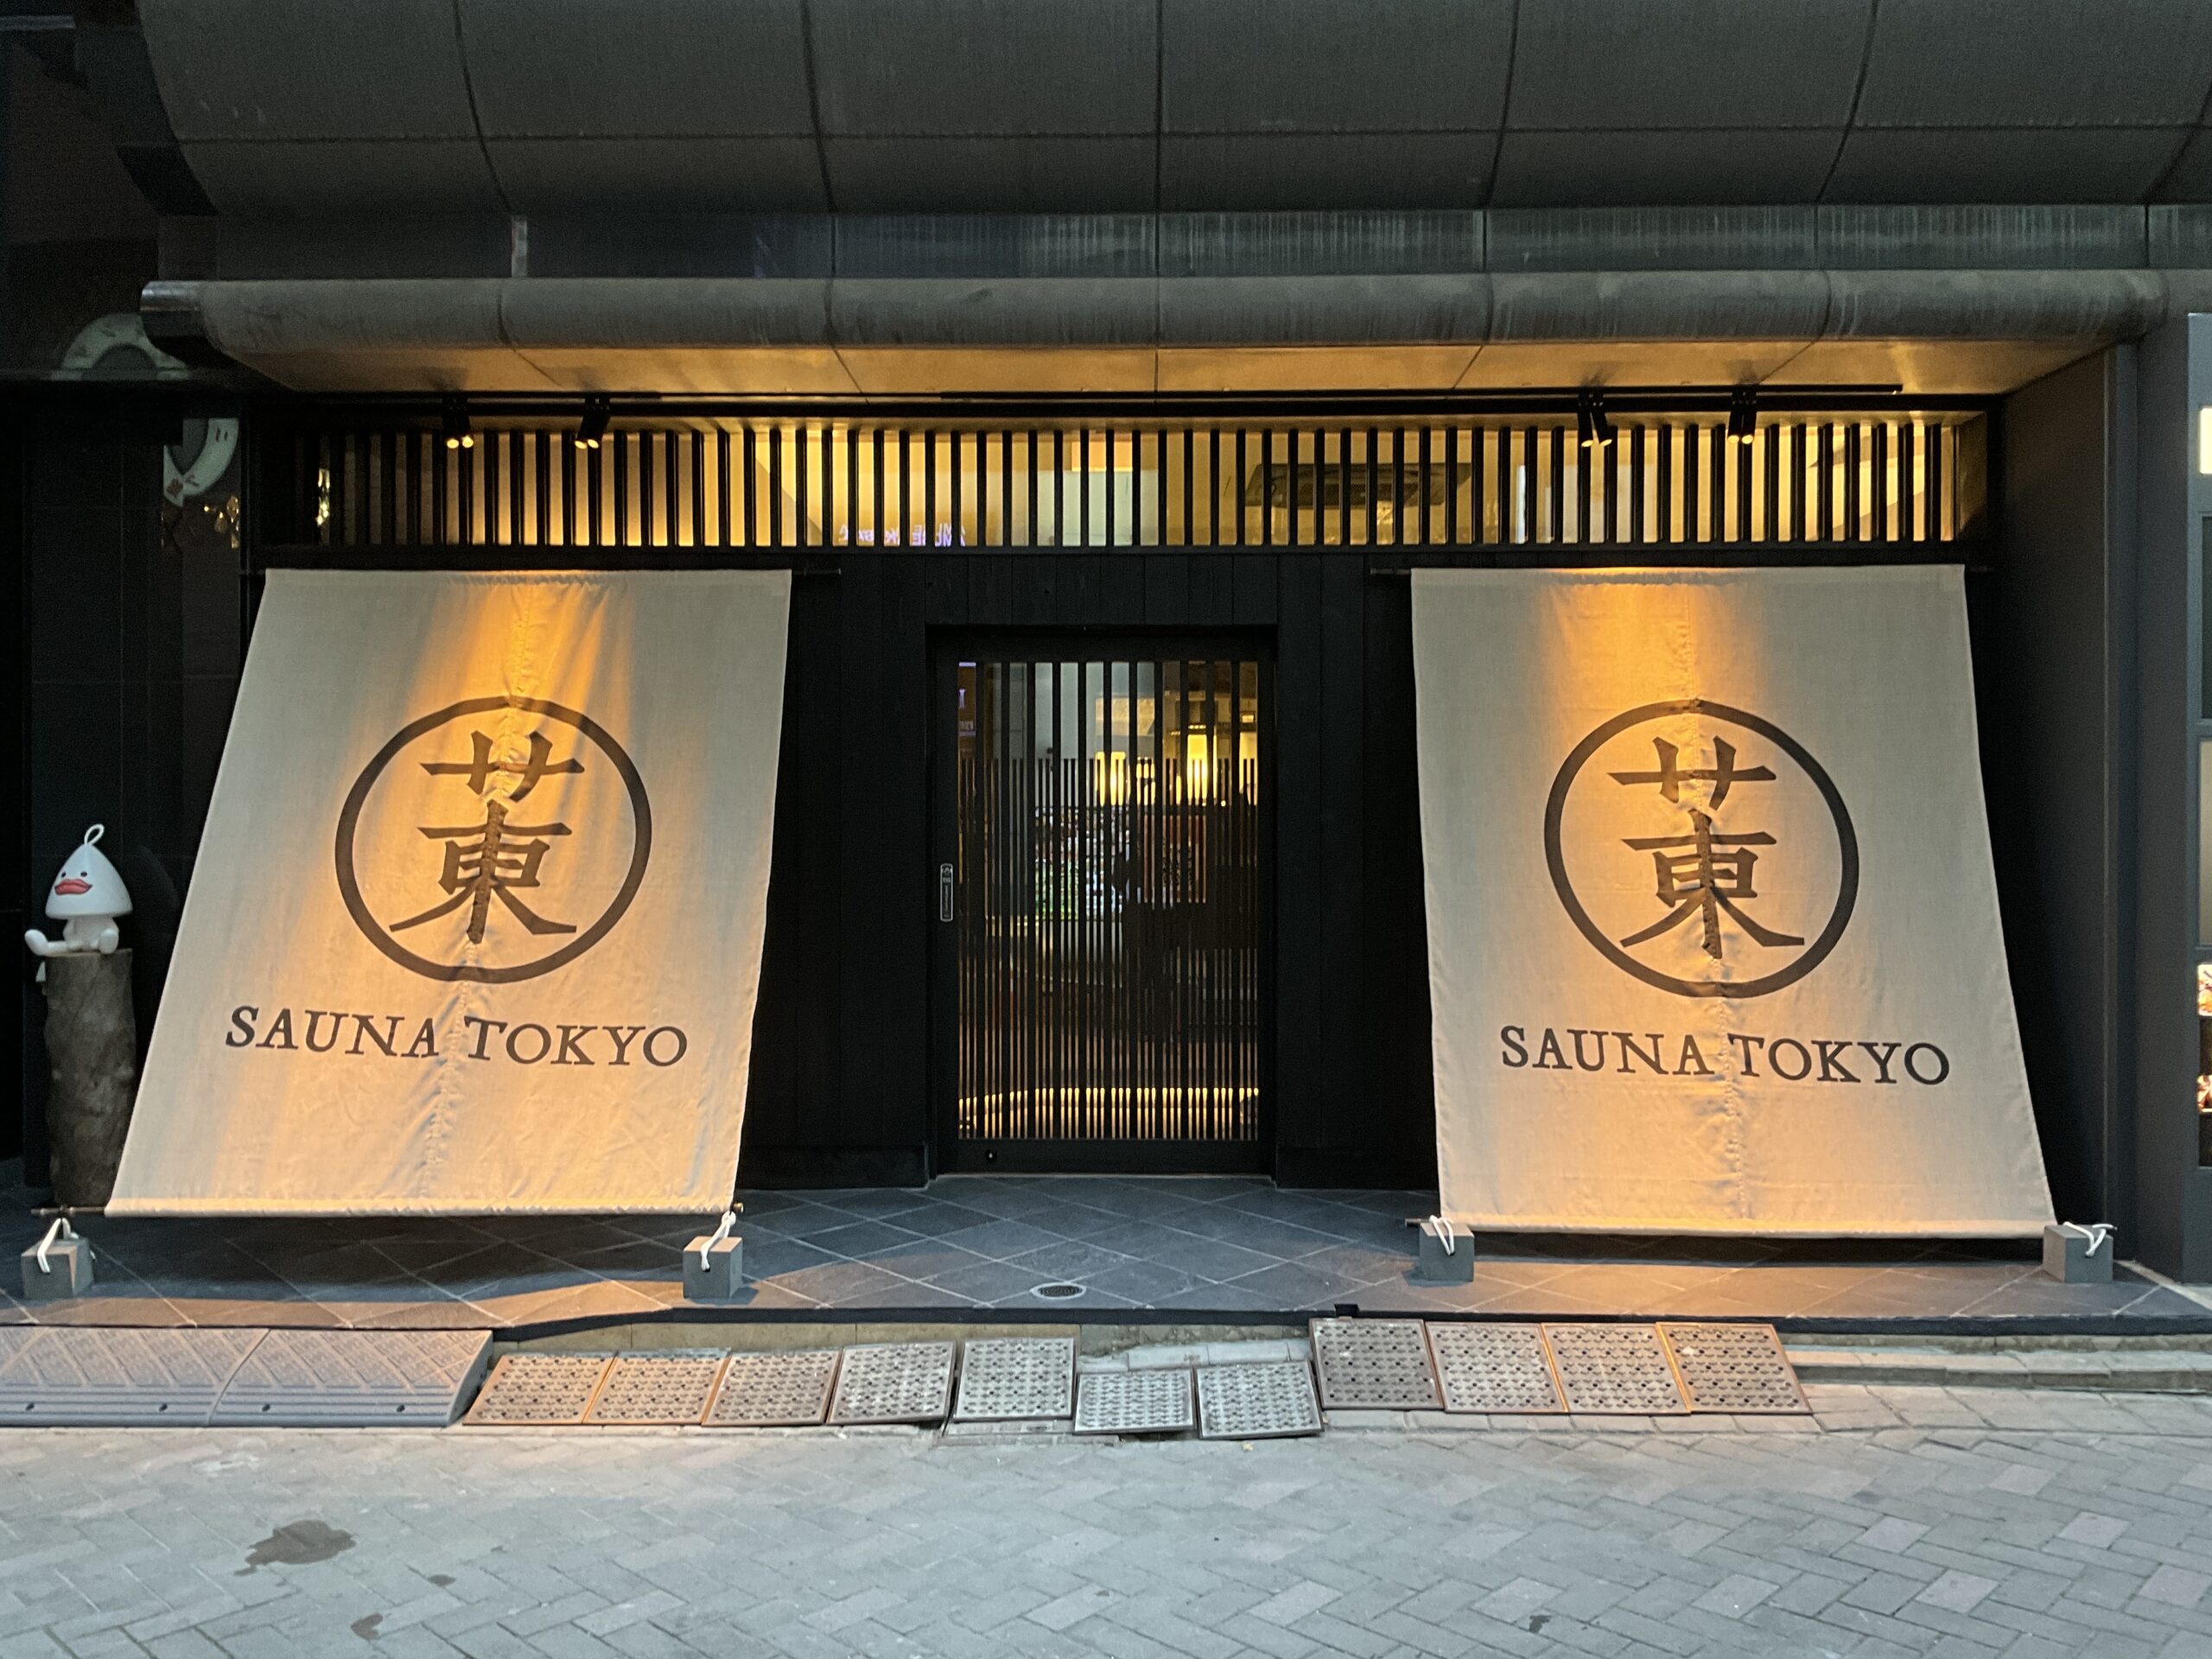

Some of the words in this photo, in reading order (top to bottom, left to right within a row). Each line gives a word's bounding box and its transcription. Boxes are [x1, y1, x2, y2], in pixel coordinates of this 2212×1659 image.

[225, 1006, 440, 1058] SAUNA
[463, 1015, 688, 1067] TOKYO
[1500, 1025, 1715, 1076] SAUNA
[1728, 1033, 1950, 1085] TOKYO
